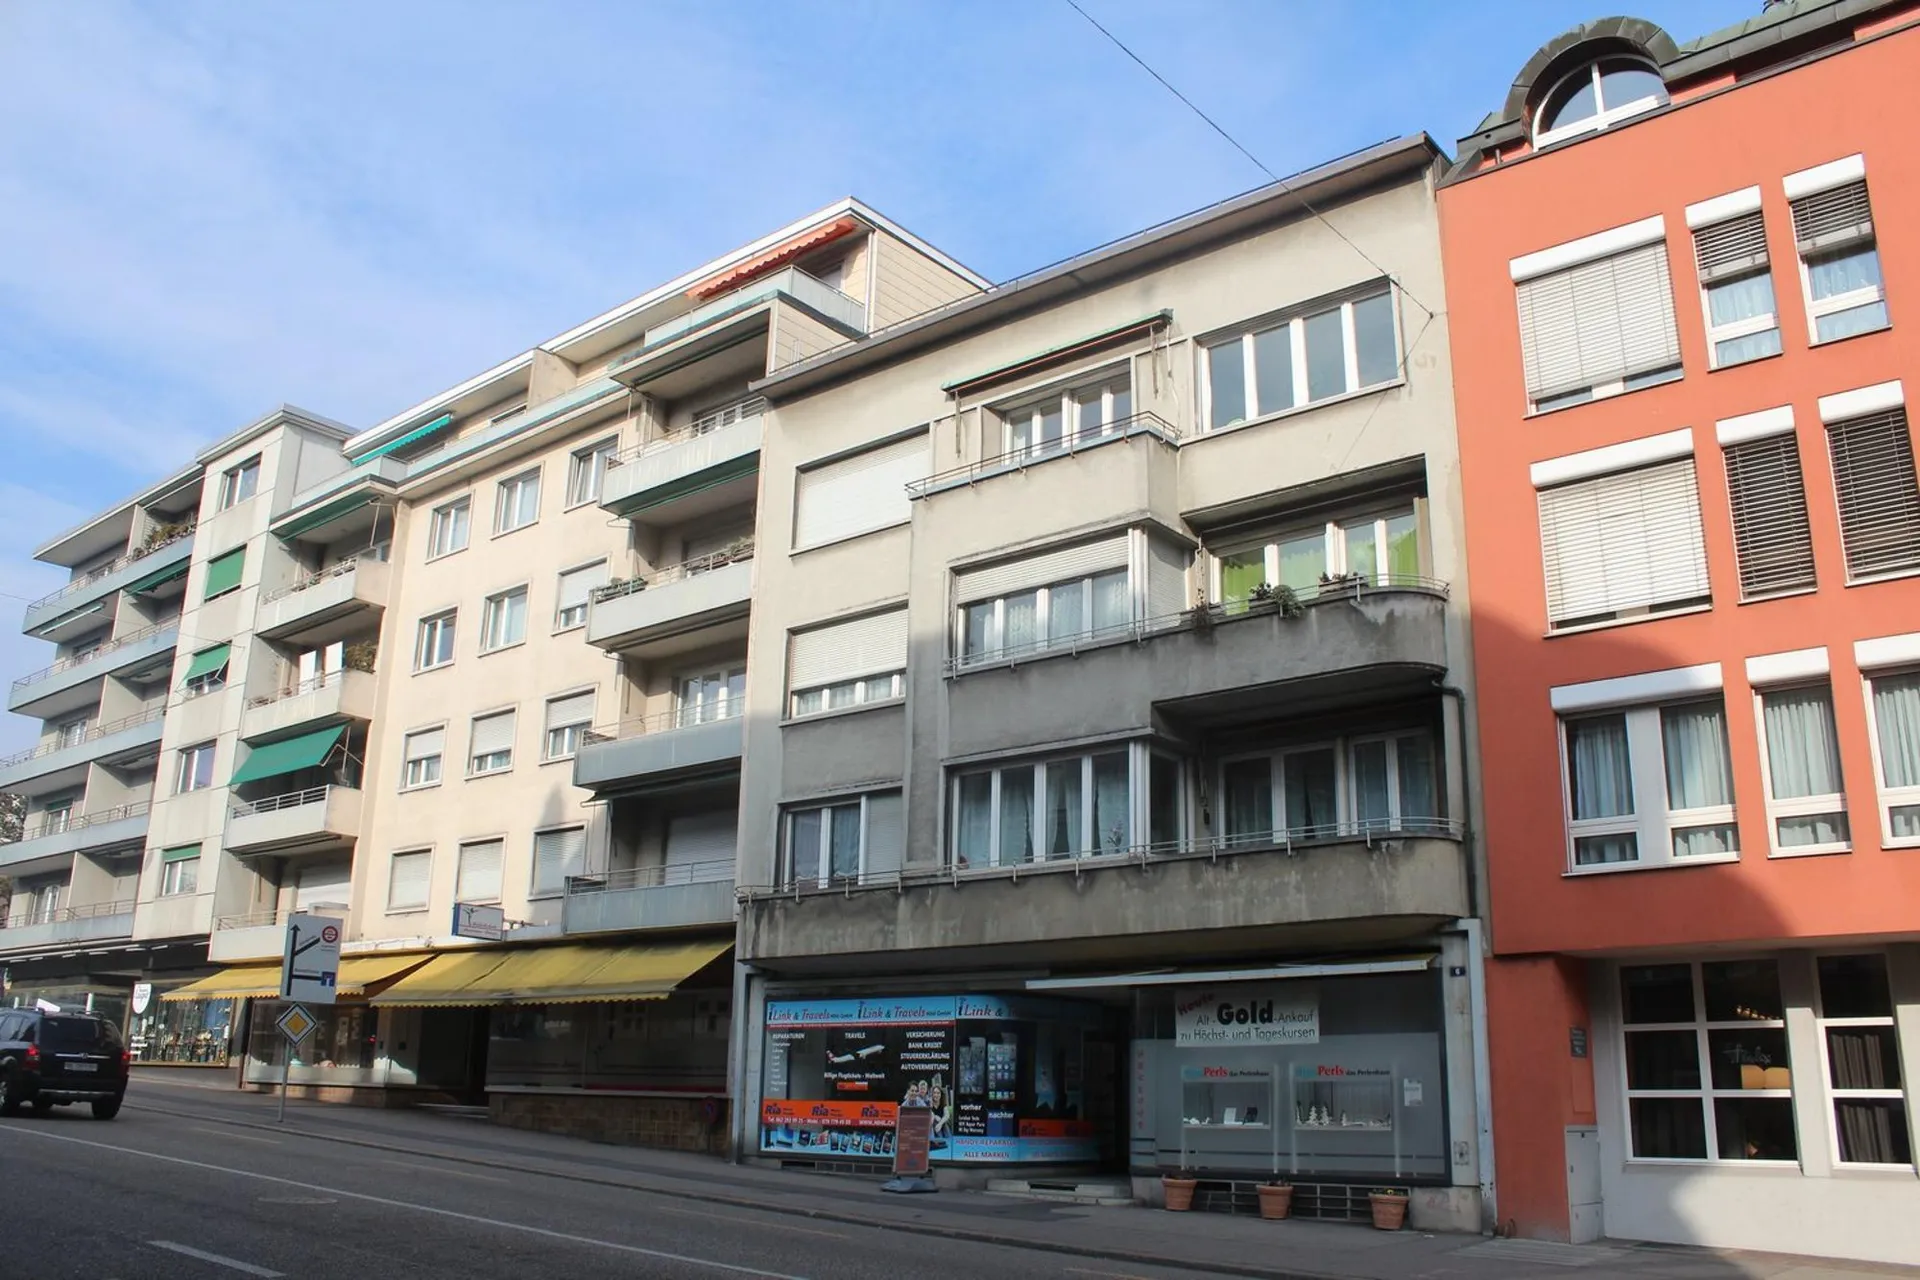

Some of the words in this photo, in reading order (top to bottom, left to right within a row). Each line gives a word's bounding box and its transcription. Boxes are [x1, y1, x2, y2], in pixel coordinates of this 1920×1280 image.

[793, 1012, 799, 1020] &
[802, 1009, 830, 1019] Travels
[885, 1010, 891, 1018] &
[894, 1006, 926, 1017] Travels
[995, 1008, 1003, 1017] &
[1217, 999, 1274, 1025] Gold
[906, 1031, 946, 1039] VERSICHERUNG
[1180, 1032, 1191, 1040] zu
[1232, 1028, 1250, 1039] und
[1255, 1027, 1316, 1041] Tageskursen
[900, 1052, 950, 1060] STEUERERKLÄRUNG
[1204, 1066, 1228, 1077] Perls
[1317, 1065, 1344, 1077] Perls
[765, 1102, 781, 1115] Ria
[812, 1103, 829, 1116] Ria
[861, 1104, 879, 1117] Ria
[964, 1151, 980, 1159] ALLE
[982, 1151, 1009, 1159] MARKEN
